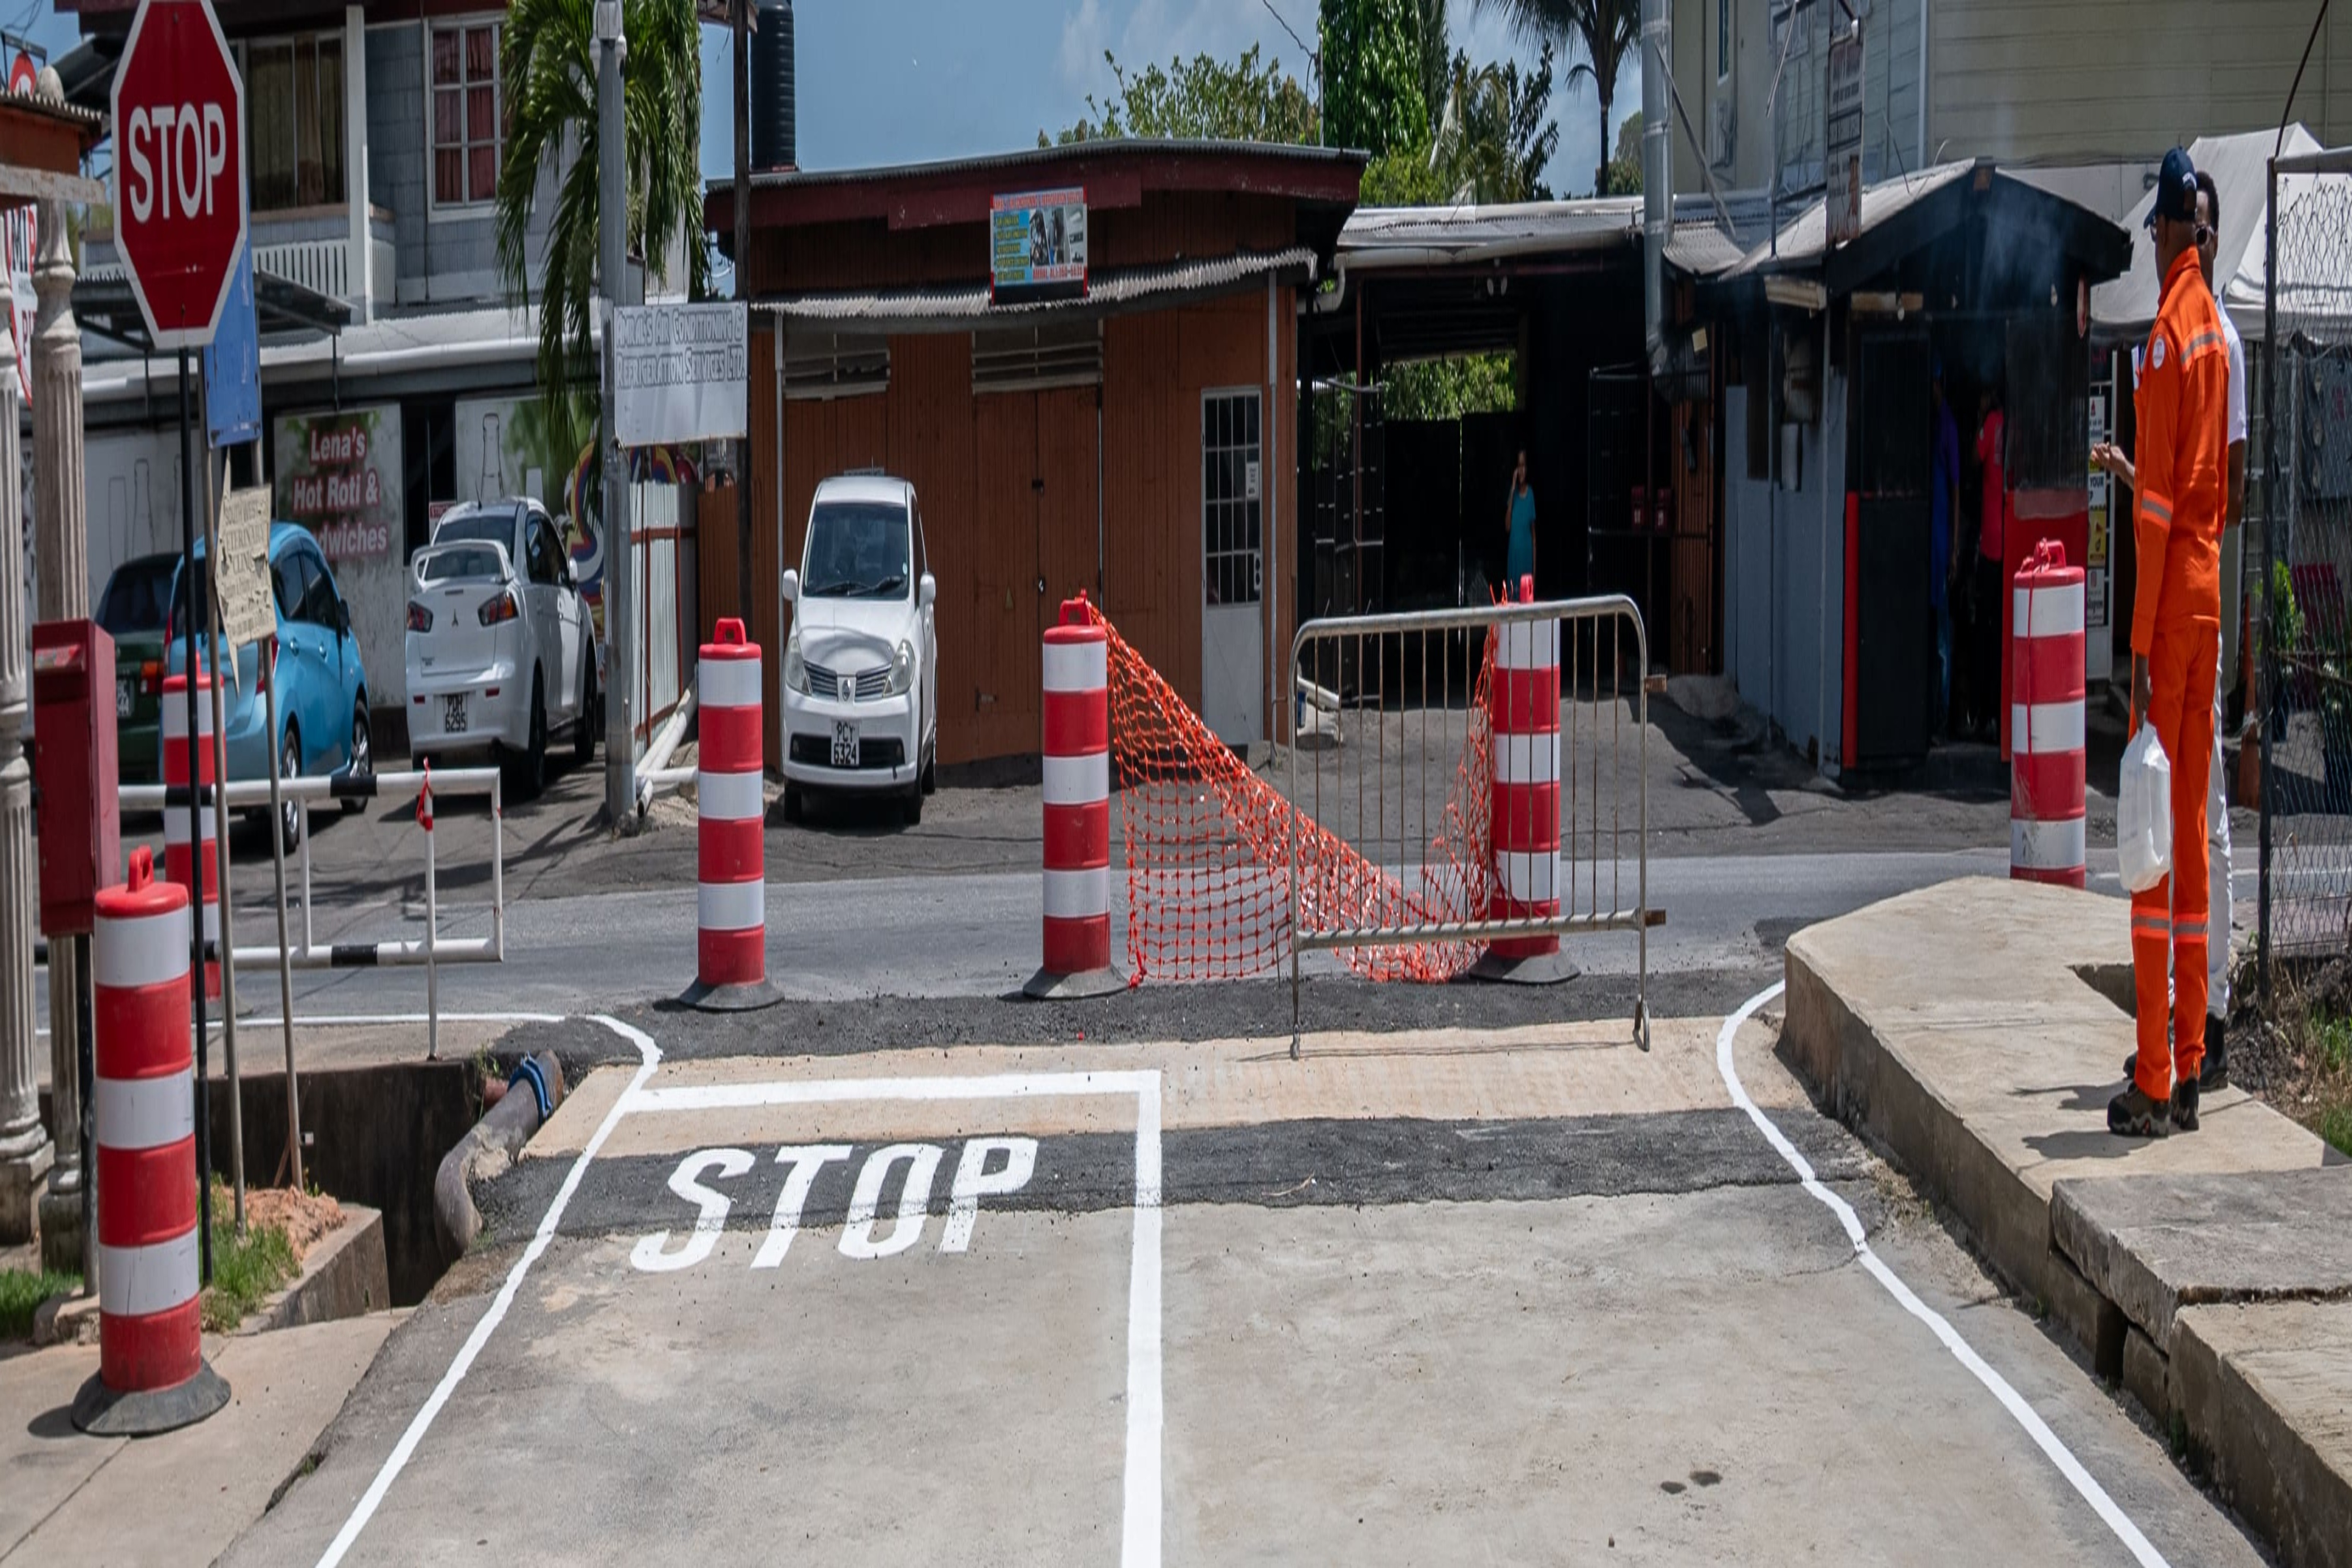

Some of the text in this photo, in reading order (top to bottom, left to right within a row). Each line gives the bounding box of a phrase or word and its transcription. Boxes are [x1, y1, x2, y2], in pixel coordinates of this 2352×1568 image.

[128, 102, 227, 223] STOP
[616, 307, 744, 348] AMRAL'S AIR CONDITIONING &
[616, 351, 684, 390] REFRIGERATION
[685, 346, 726, 384] SERVICES
[310, 426, 367, 461] Lena's
[294, 470, 379, 510] Hot Roti &
[315, 522, 387, 556] dwiches
[445, 712, 466, 732] 6295
[837, 721, 855, 743] PCY
[834, 743, 857, 764] 6324
[629, 1137, 1038, 1272] STOP
